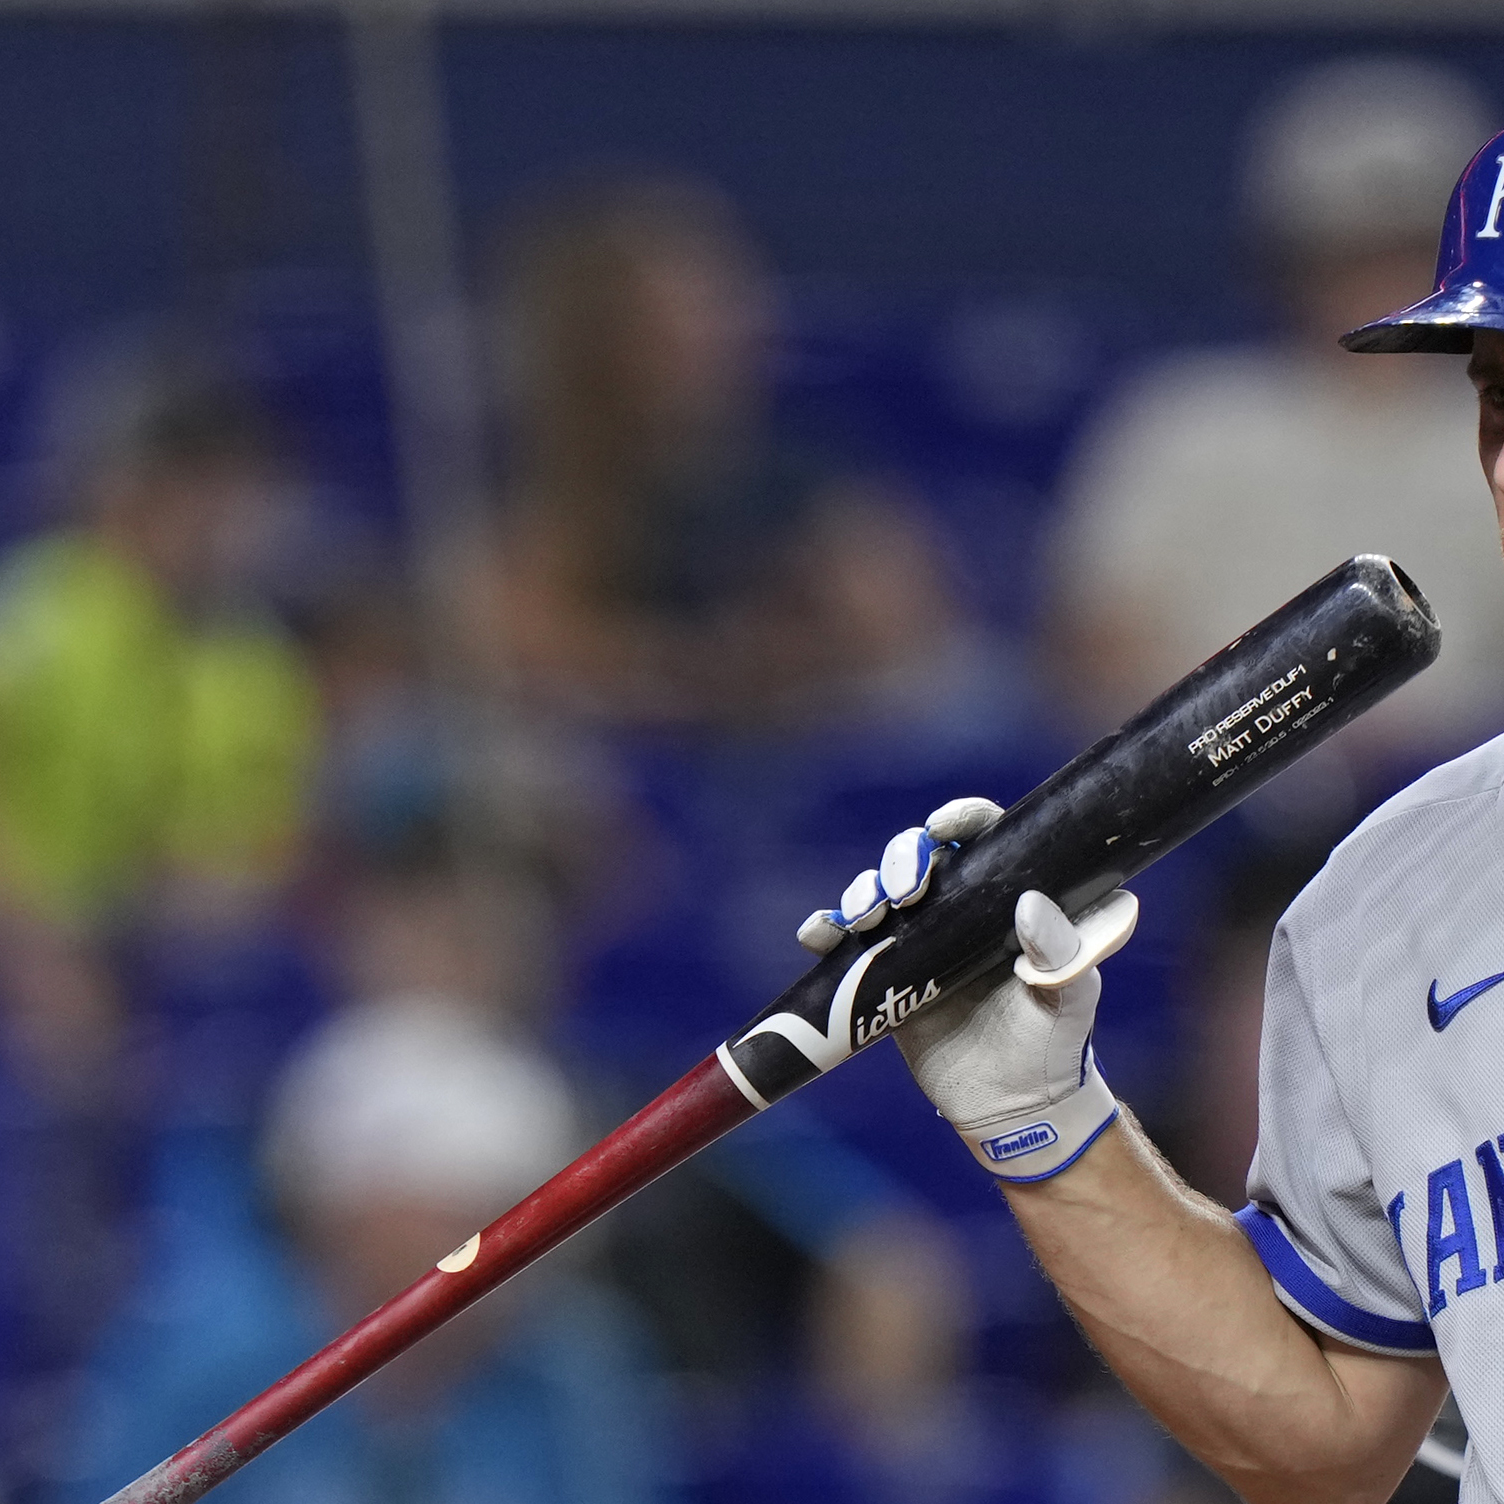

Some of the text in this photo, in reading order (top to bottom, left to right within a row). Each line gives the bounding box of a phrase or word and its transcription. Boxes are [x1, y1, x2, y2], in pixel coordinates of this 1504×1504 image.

[1187, 663, 1307, 755] PRO RESERVE DUF1
[1207, 684, 1313, 768] MATT DUFFY
[732, 935, 942, 1073] Victus
[989, 1129, 1050, 1160] Franklin
